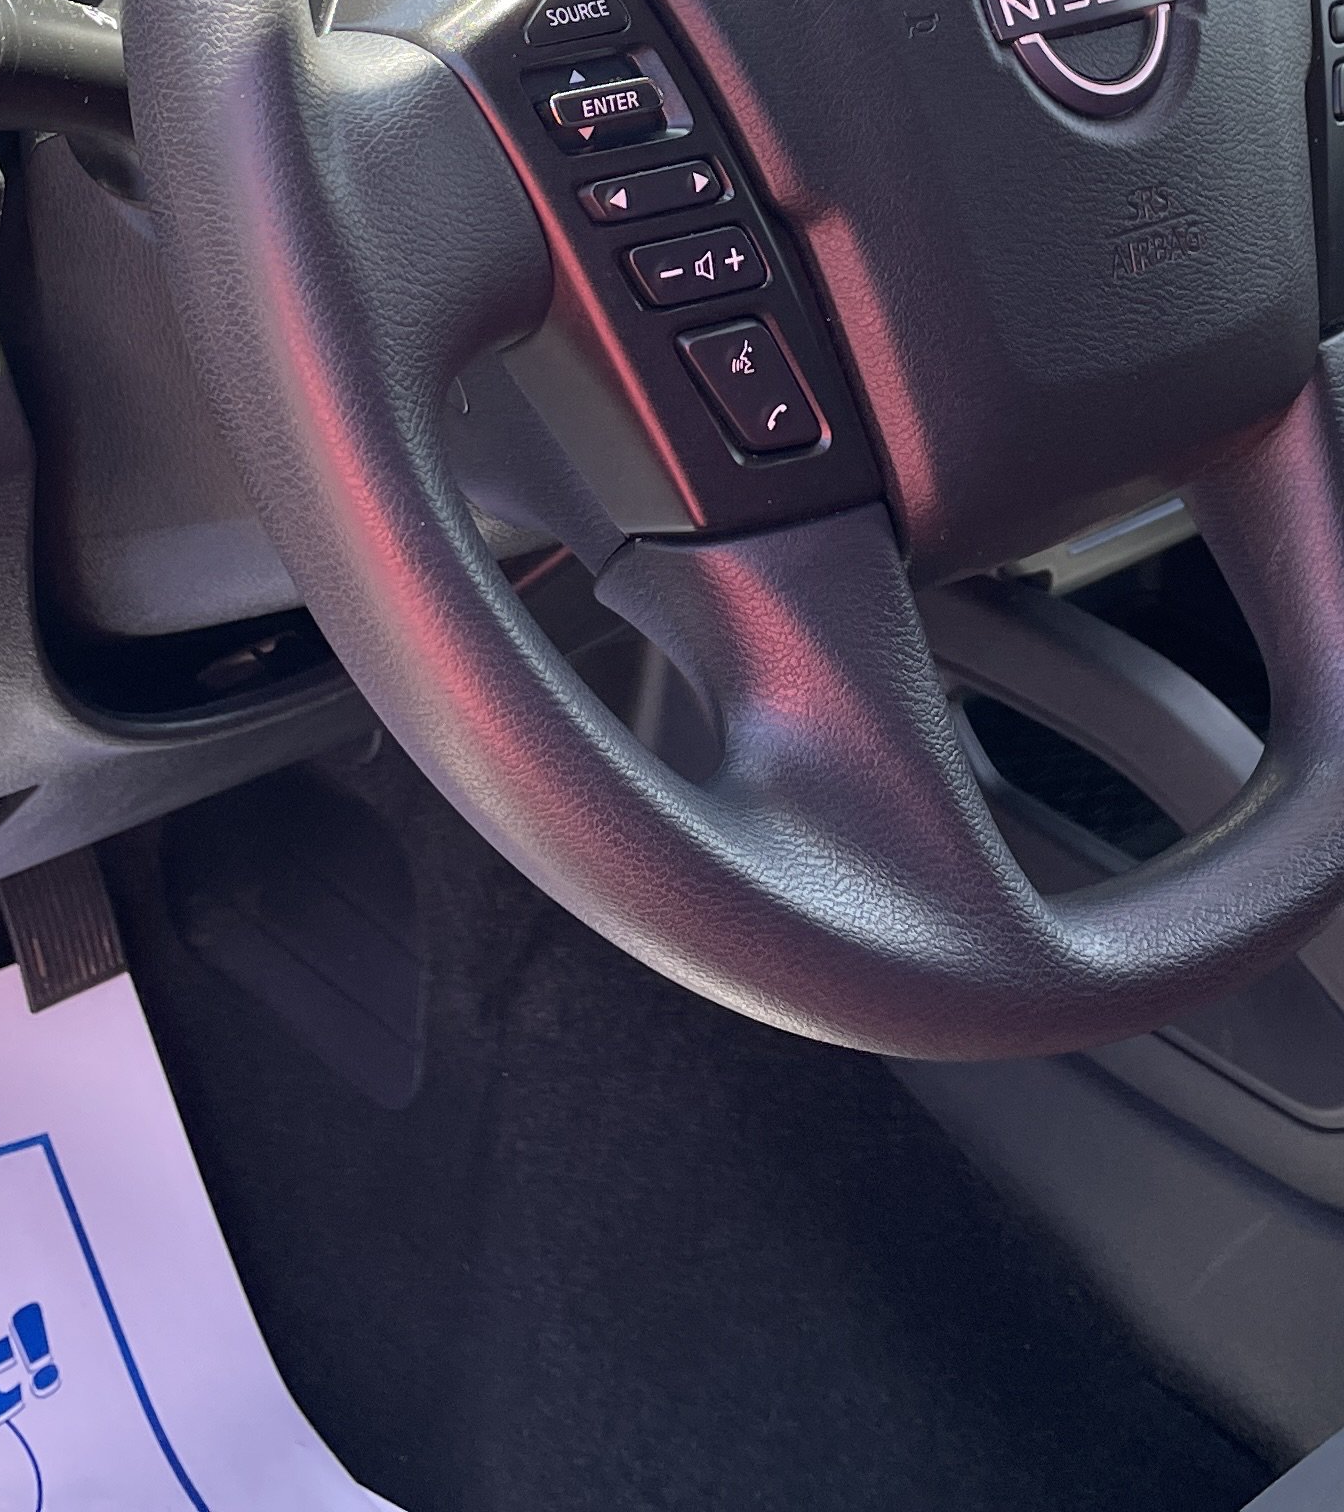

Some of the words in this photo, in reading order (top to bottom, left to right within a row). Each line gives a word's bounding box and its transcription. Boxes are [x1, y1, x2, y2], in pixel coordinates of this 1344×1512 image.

[582, 91, 640, 118] ENTER
[1127, 187, 1169, 223] SRS
[1114, 226, 1207, 281] AIRBAG
